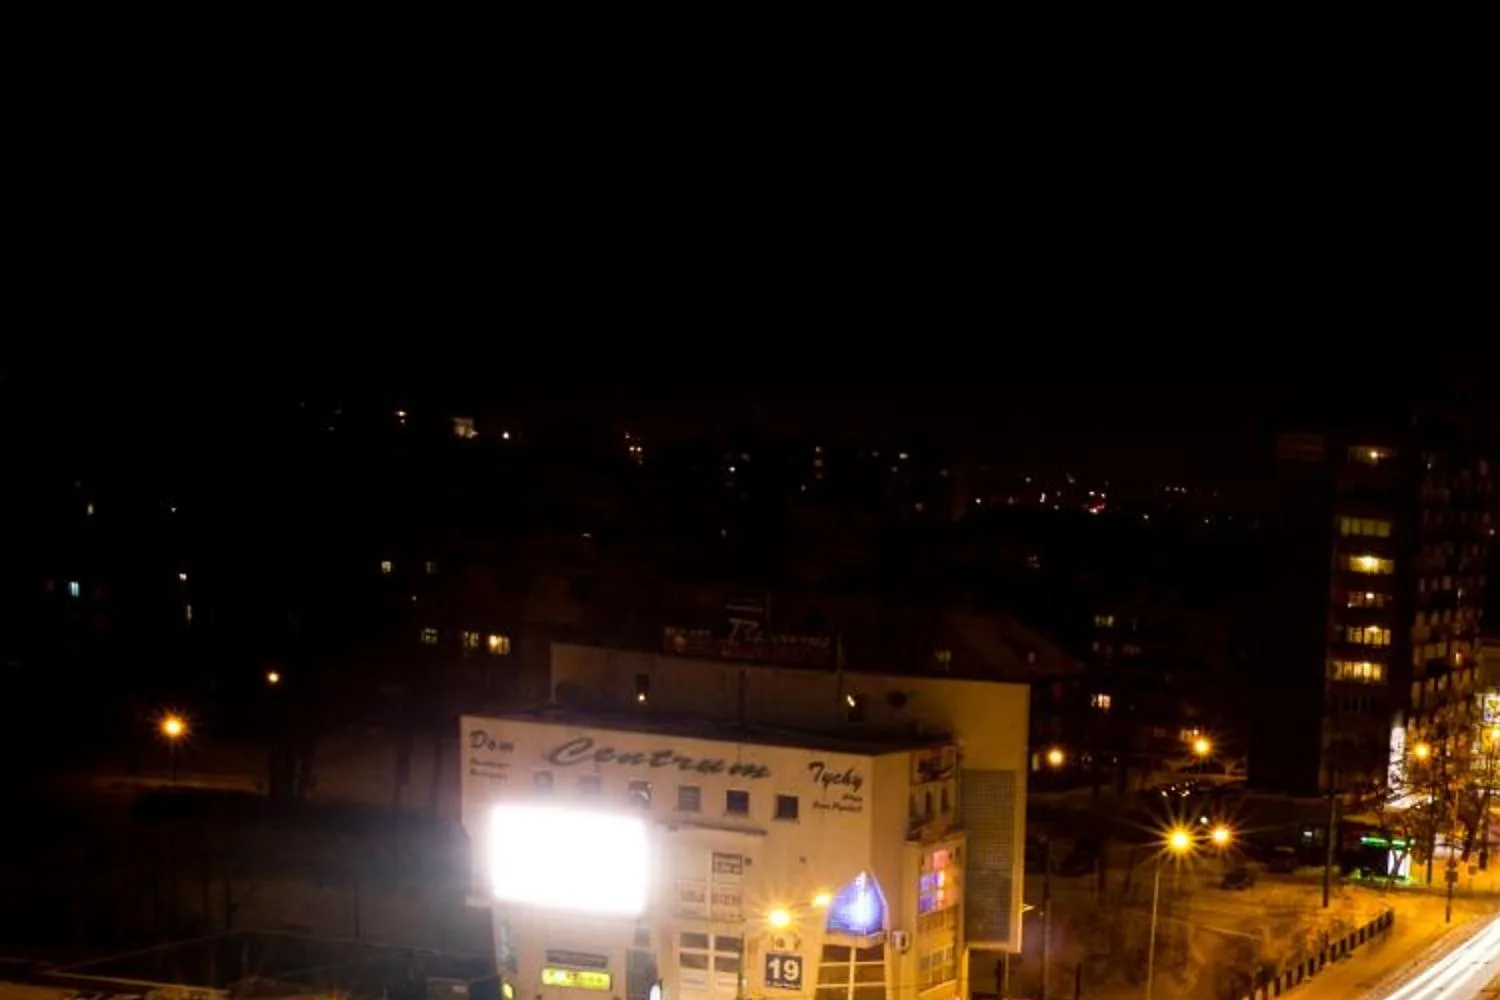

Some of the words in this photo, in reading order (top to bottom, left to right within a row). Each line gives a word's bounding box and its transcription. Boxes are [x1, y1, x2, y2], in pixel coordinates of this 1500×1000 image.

[543, 736, 770, 779] Centrum
[808, 761, 863, 792] Tychy
[768, 958, 799, 981] 19
